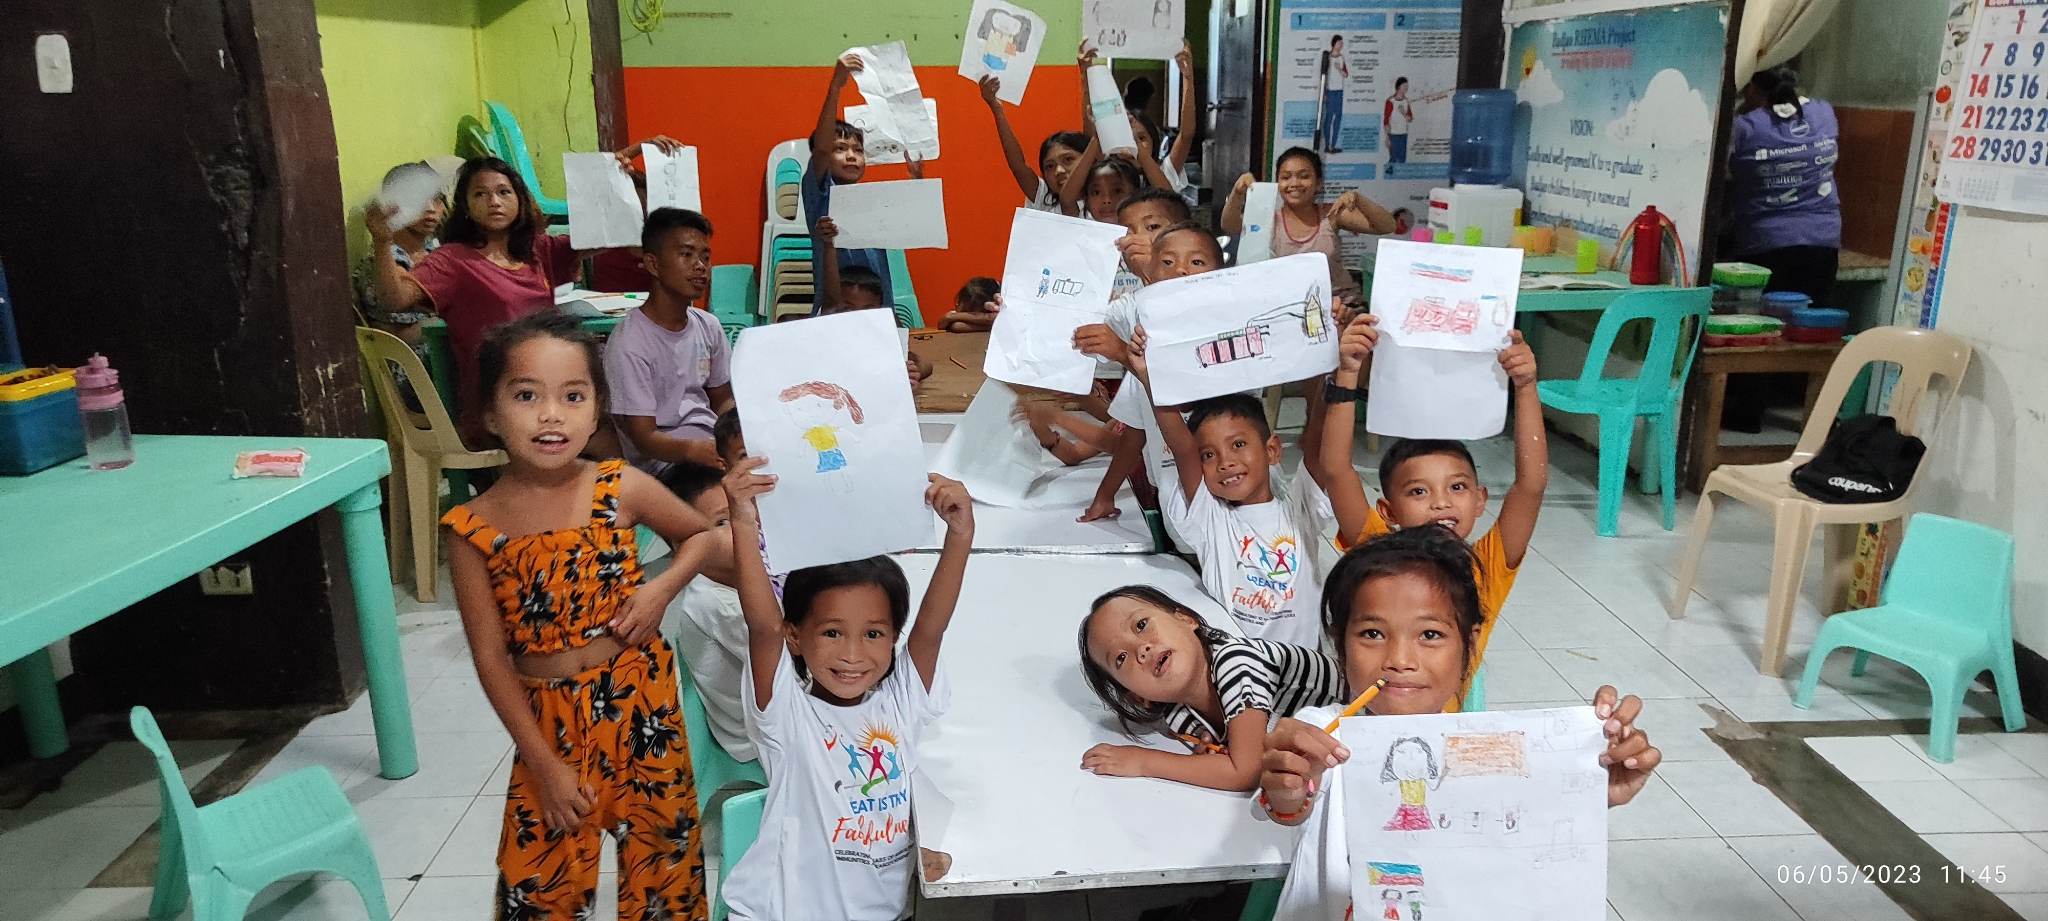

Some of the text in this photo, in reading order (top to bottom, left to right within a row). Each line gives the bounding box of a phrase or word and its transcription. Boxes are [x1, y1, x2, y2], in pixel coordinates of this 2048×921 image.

[1396, 14, 1406, 27] 2
[2015, 9, 2026, 35] 1
[1980, 41, 2045, 67] 7 8 9
[1968, 73, 2040, 100] 14 15 16
[1961, 104, 1983, 130] 21
[1984, 105, 2009, 131] 22
[2009, 106, 2034, 132] 23
[1769, 143, 1808, 157] Microsoft
[1949, 134, 1977, 161] 28
[1977, 136, 2002, 162] 29
[2001, 137, 2027, 164] 30
[878, 797, 888, 812] IS
